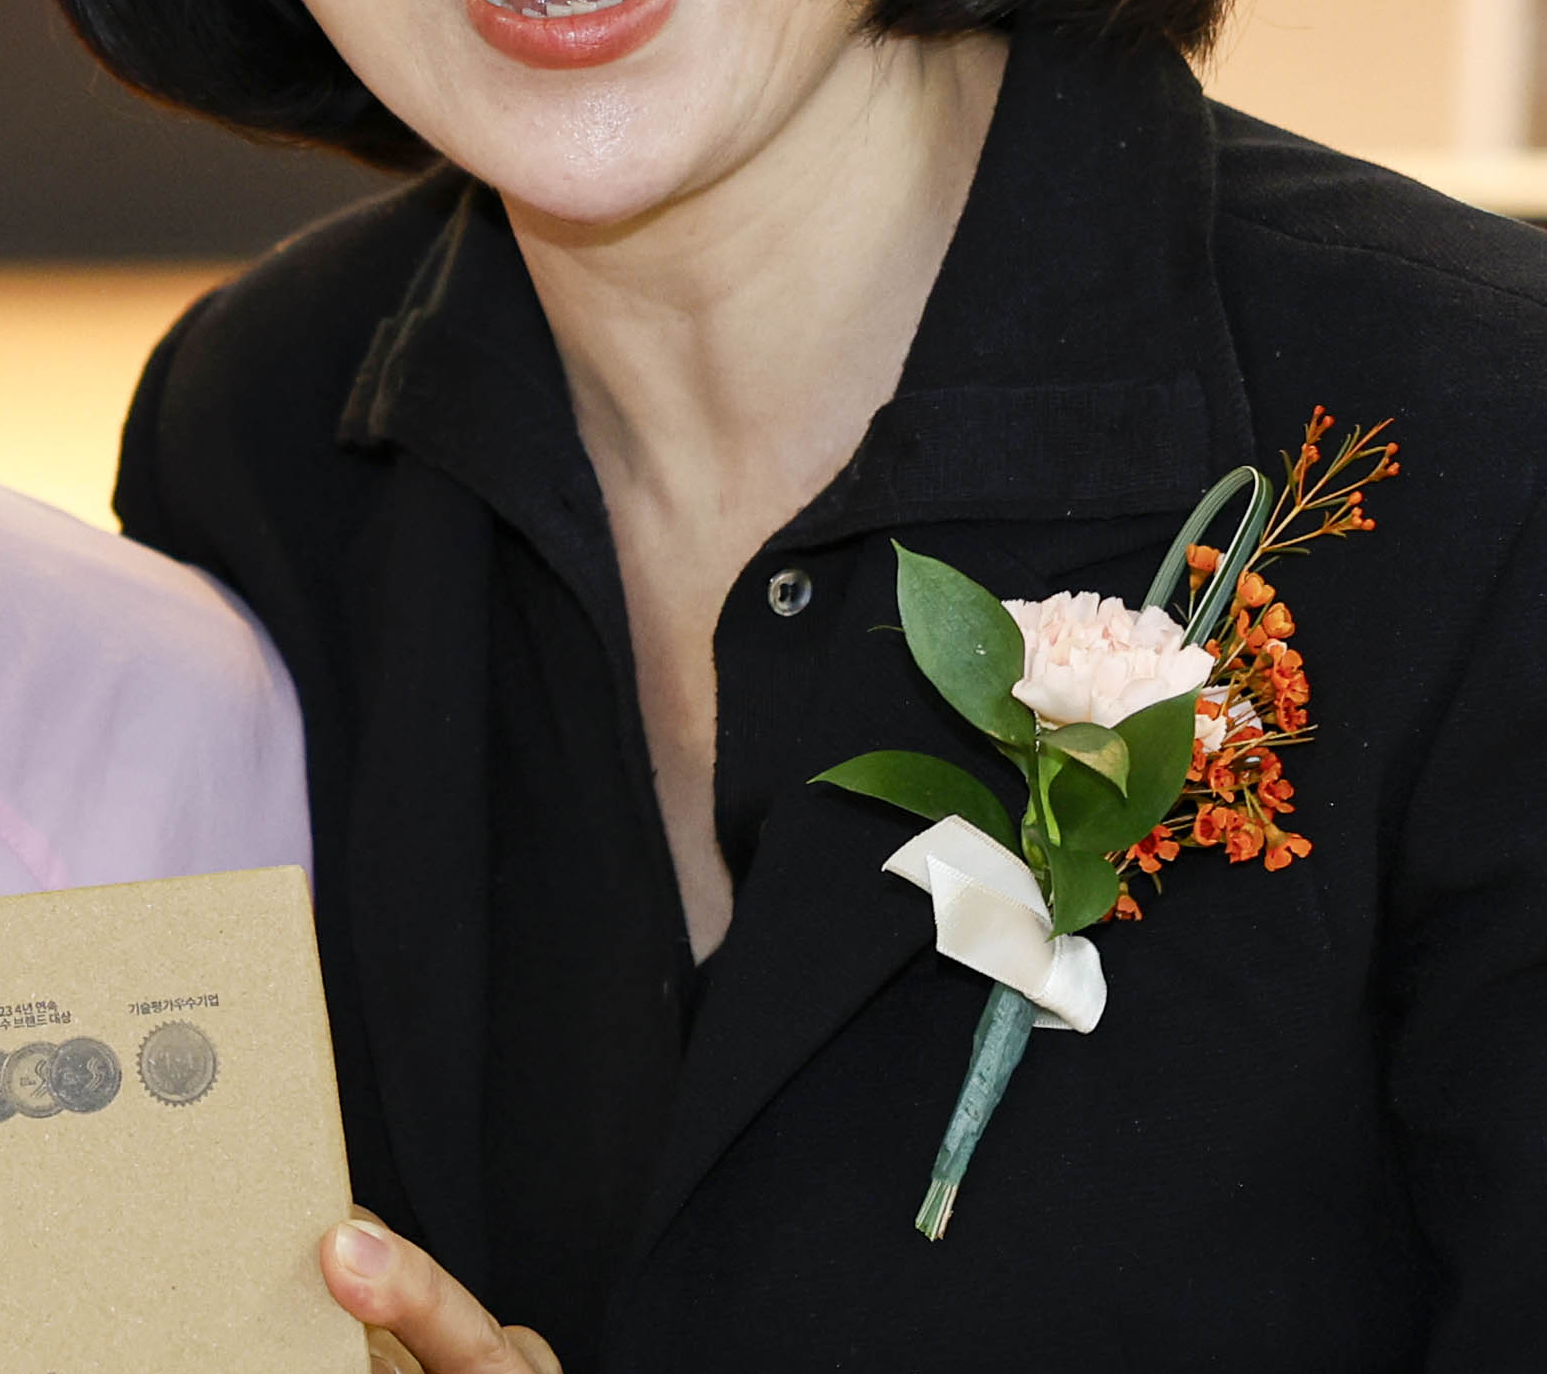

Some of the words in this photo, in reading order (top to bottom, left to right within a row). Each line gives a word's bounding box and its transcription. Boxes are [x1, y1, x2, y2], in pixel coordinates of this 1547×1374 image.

[14, 1001, 33, 1015] 4년
[13, 1014, 47, 1029] 브랜드
[49, 1010, 72, 1025] 대상
